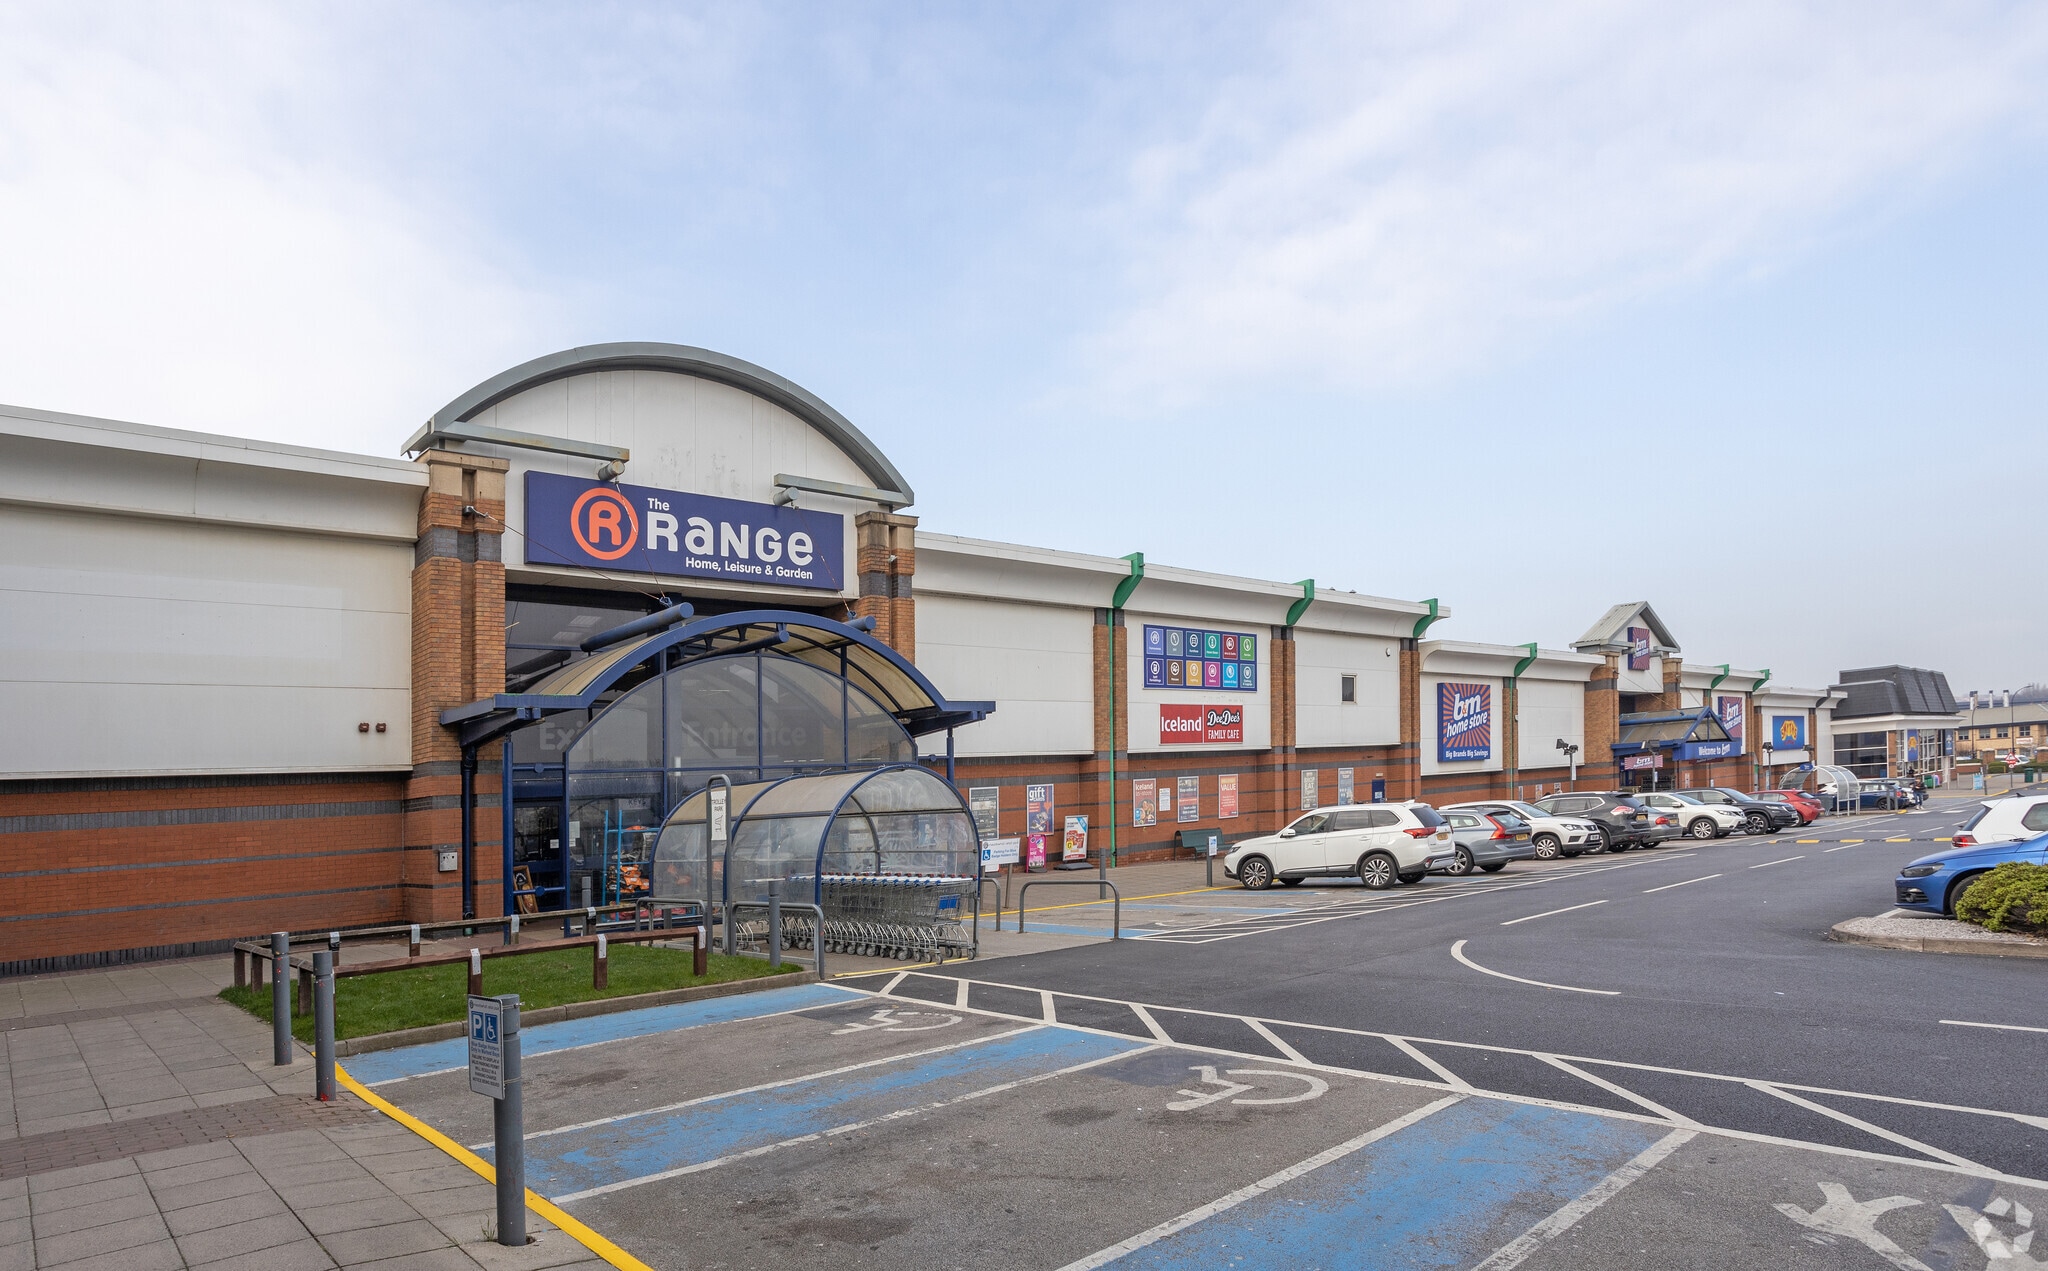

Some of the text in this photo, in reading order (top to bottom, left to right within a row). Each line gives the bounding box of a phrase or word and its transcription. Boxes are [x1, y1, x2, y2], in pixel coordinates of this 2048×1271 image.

[647, 497, 670, 511] The
[685, 556, 813, 580] Home, Leisure & Garden
[1161, 716, 1202, 732] Iceland
[1446, 711, 1488, 738] home store
[687, 720, 807, 749] Entrance
[1208, 729, 1240, 740] FAMILY CAFE
[1445, 750, 1453, 759] Big
[1474, 749, 1489, 758] Savings
[1698, 746, 1716, 756] Welcome
[1029, 786, 1046, 801] gift
[1221, 783, 1236, 791] VALUE
[473, 1014, 482, 1037] P
